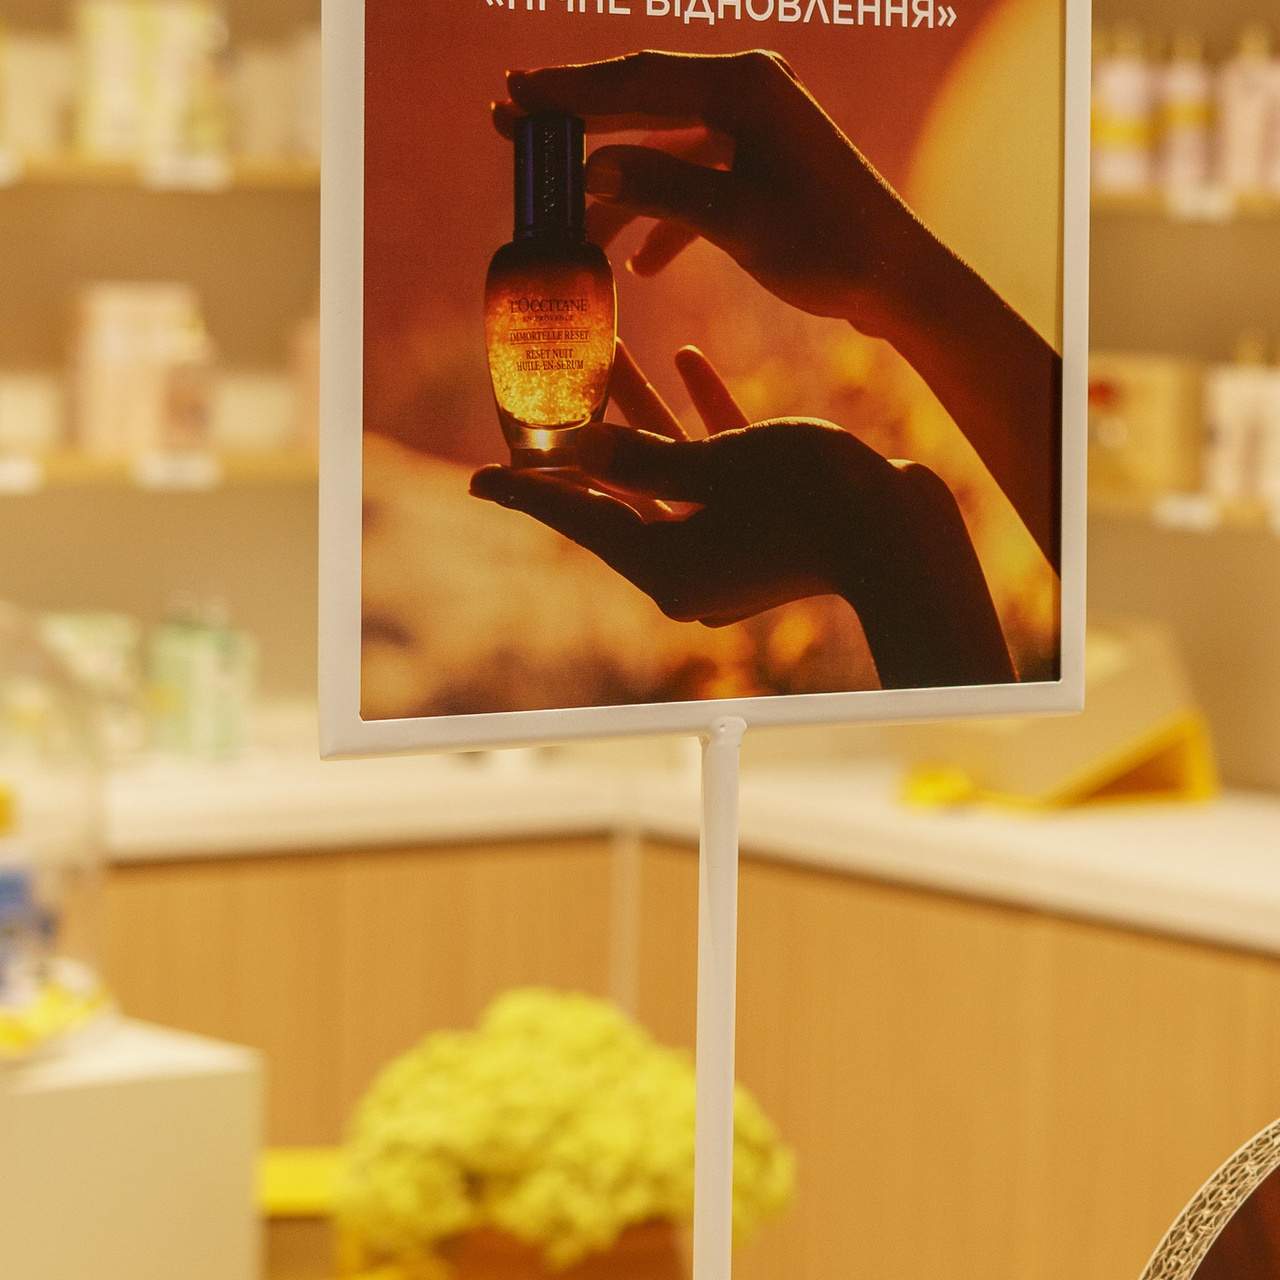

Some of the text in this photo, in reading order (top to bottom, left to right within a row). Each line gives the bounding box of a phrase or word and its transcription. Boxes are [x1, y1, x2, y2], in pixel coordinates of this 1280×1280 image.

[510, 297, 588, 314] L'OCCITANE
[510, 330, 589, 342] IMMORTELLE RESET
[526, 349, 550, 359] RESET
